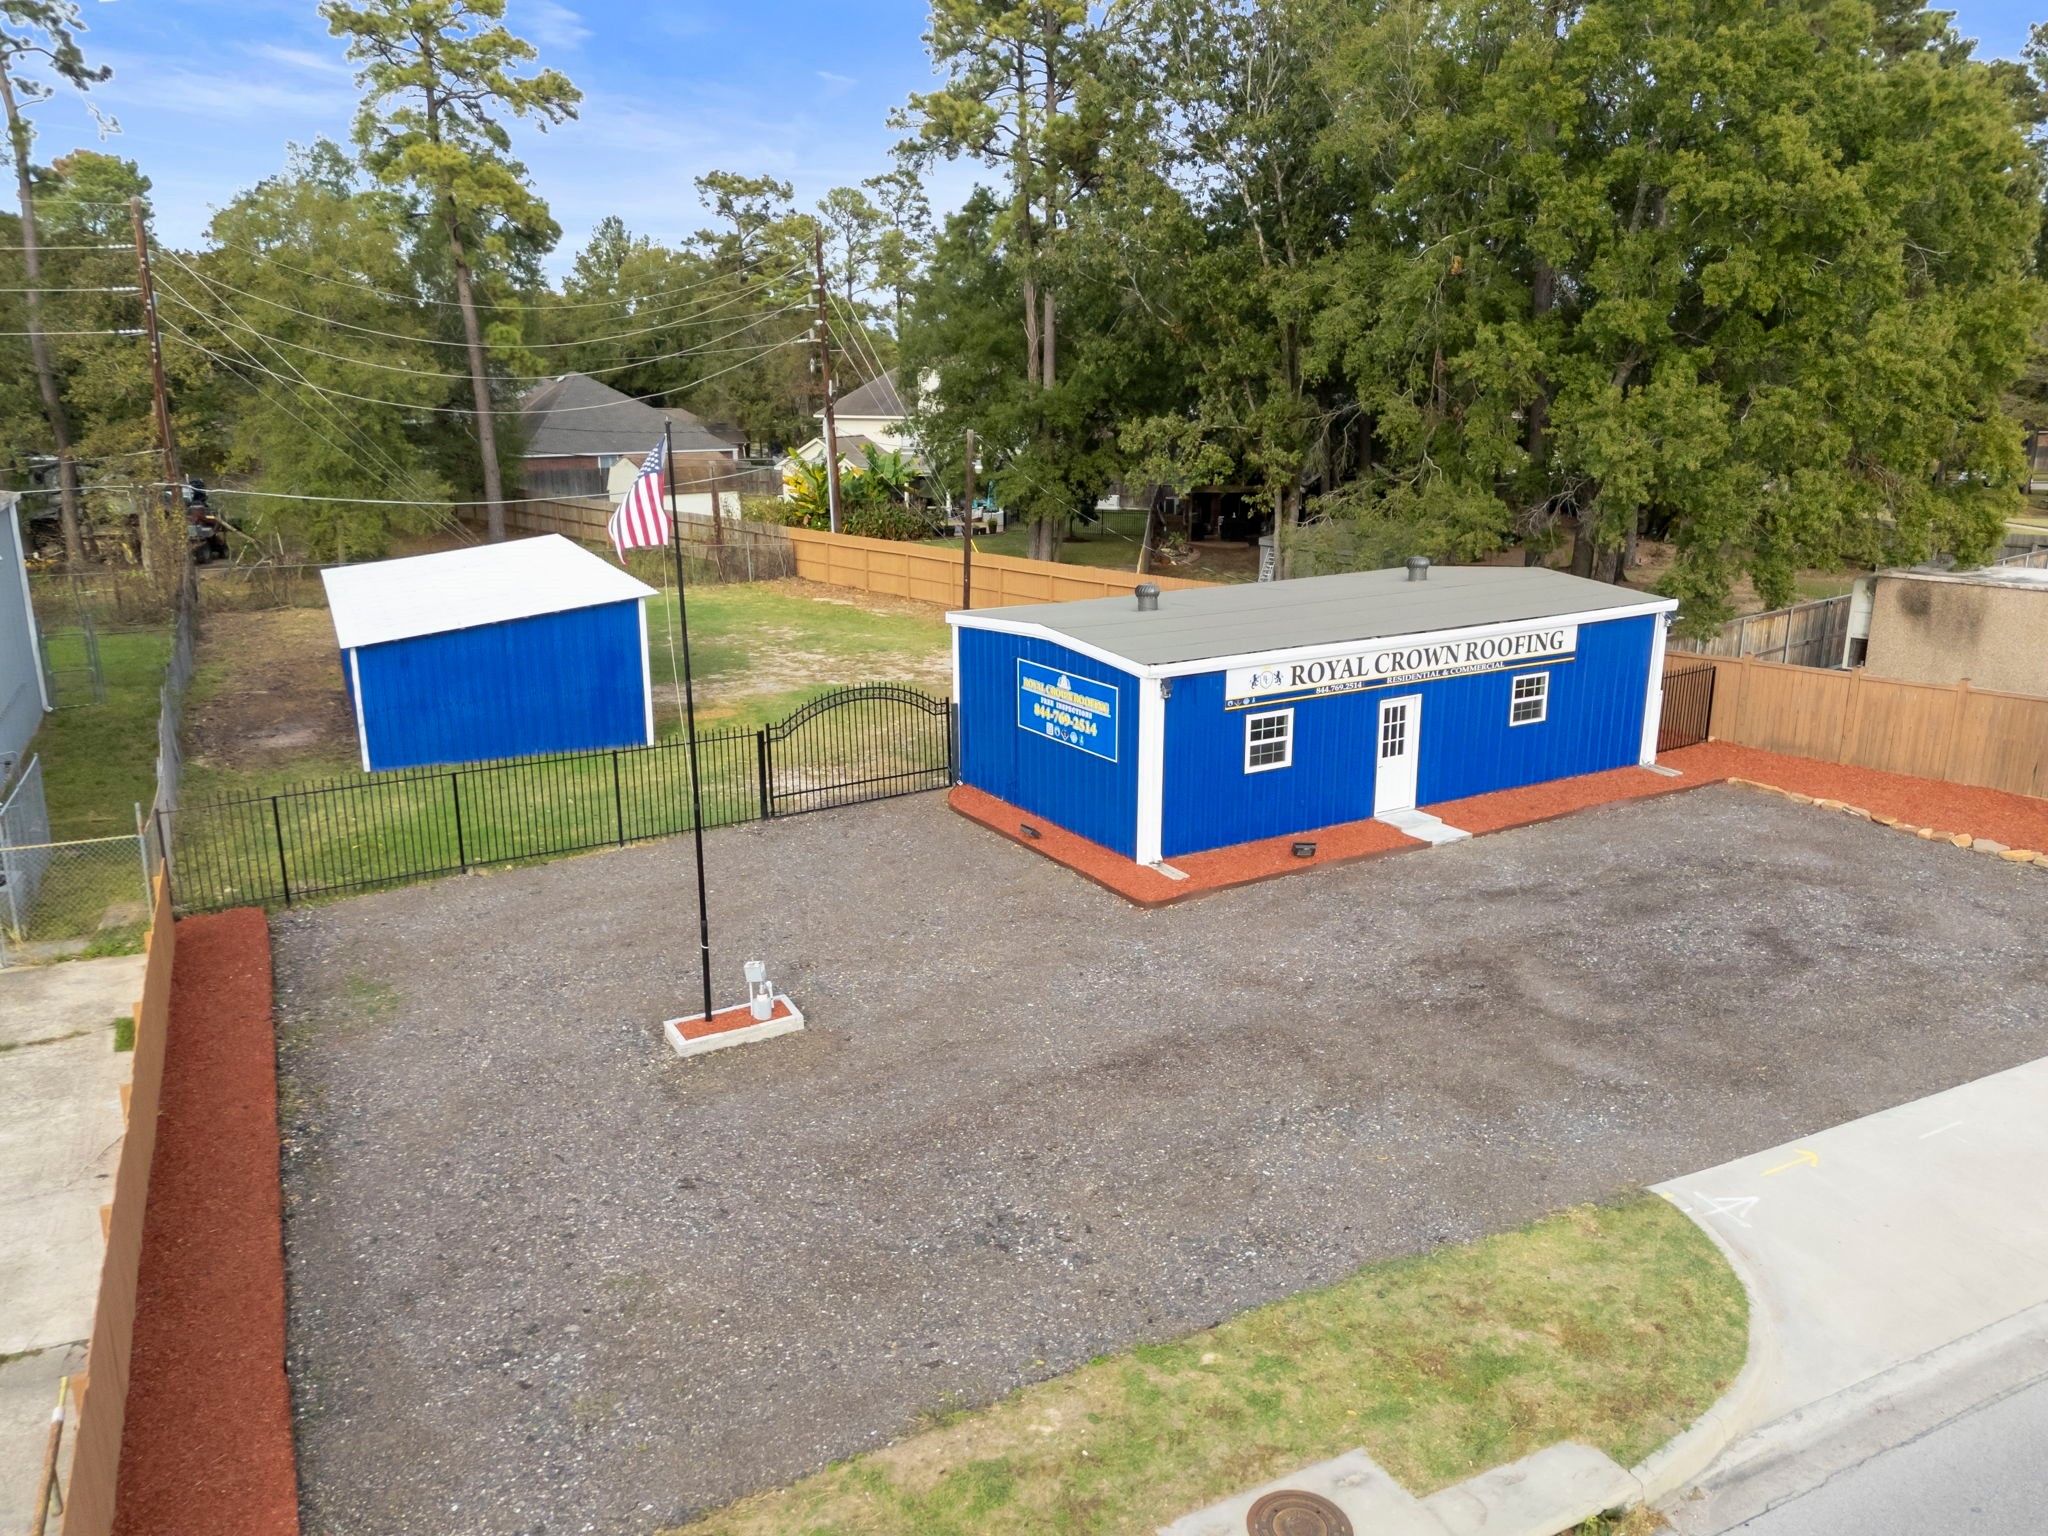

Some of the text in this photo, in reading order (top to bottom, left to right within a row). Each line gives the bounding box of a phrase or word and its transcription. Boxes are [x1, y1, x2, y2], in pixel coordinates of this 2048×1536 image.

[1290, 630, 1564, 686] ROYAL CROWN ROOFING
[1386, 669, 1441, 684] RESIDENTIAL
[1450, 661, 1505, 675] COMMERCIAL
[1023, 676, 1109, 715] ROYAL CROWN ROOFING
[1315, 682, 1362, 695] 844.769.2514
[1034, 702, 1098, 736] 844-769-2514
[1040, 696, 1093, 719] FREE INSPECTIONS
